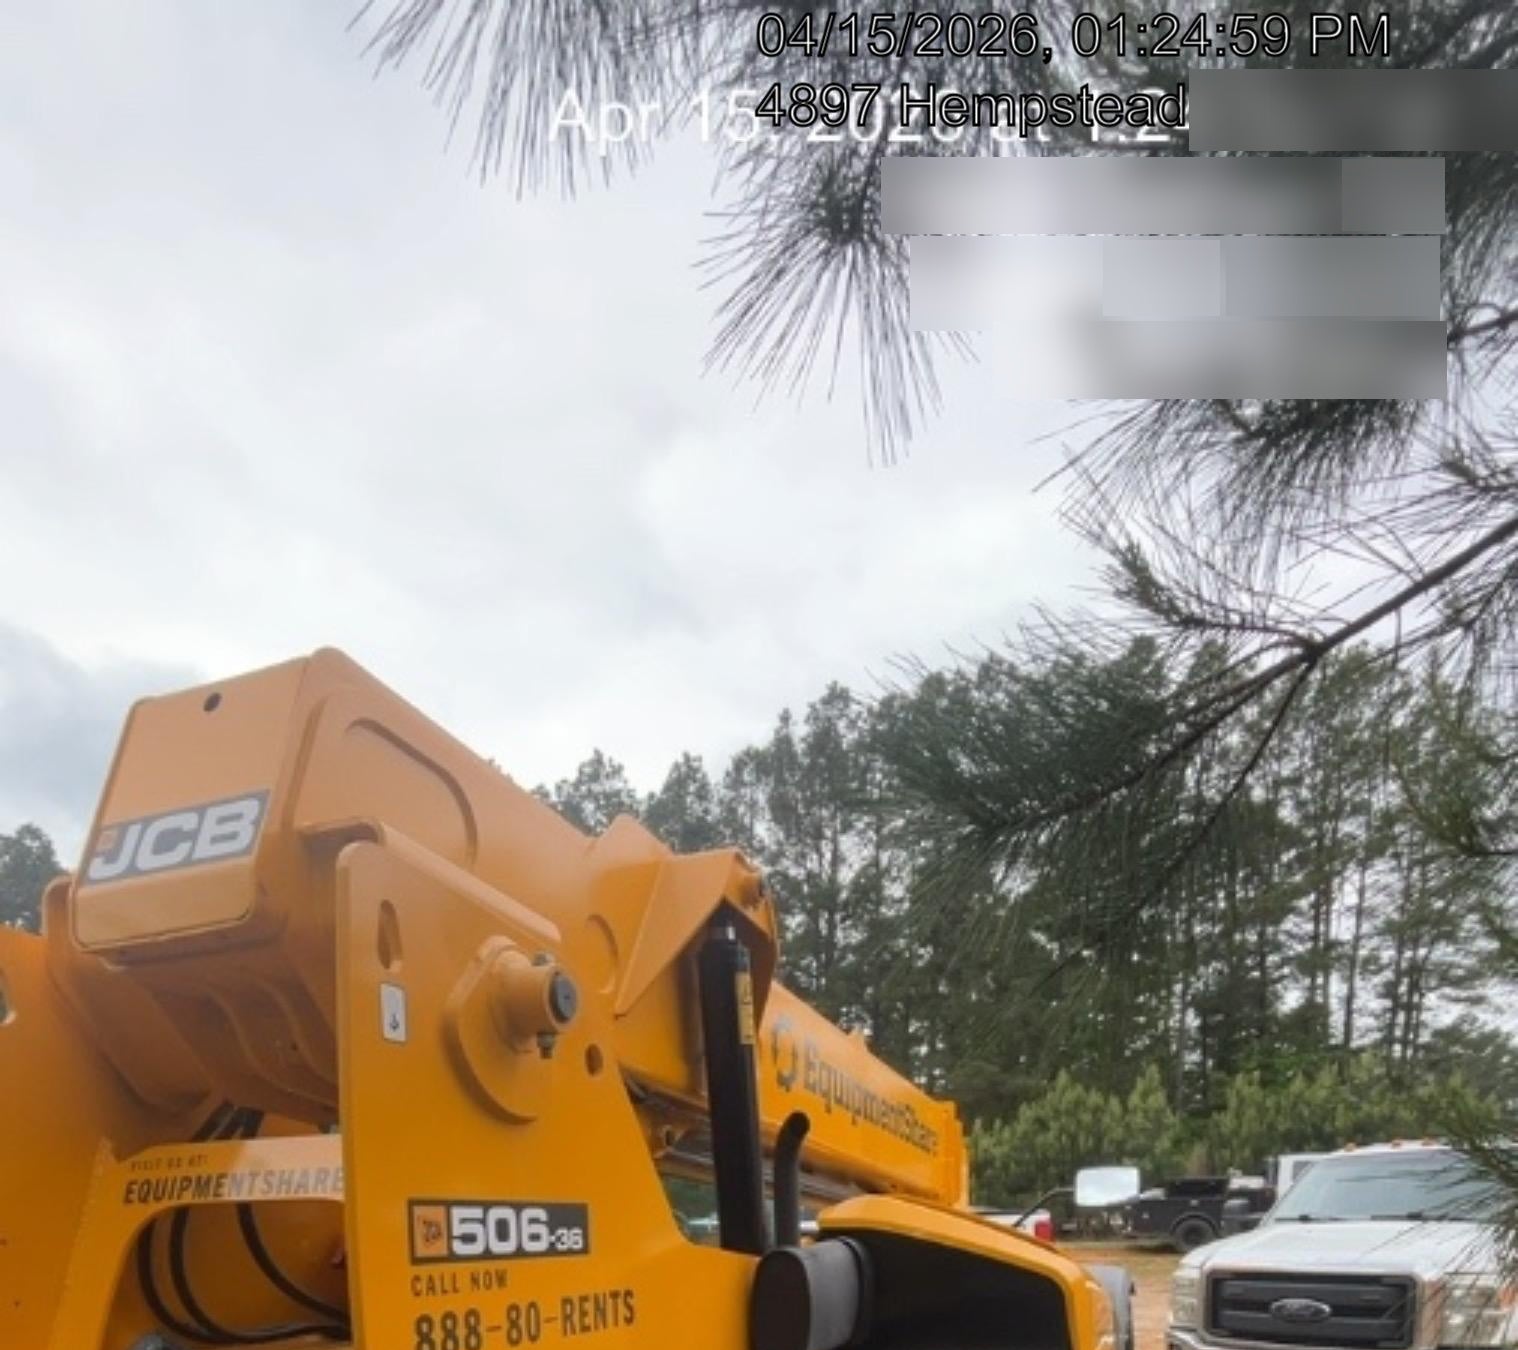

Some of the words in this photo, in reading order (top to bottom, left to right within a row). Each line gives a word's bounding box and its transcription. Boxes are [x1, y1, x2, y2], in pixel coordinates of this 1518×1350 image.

[88, 798, 260, 881] JCB
[124, 1166, 344, 1204] EQUIPMENTSHARE
[410, 1273, 461, 1297] CALL
[470, 1268, 509, 1292] NOW
